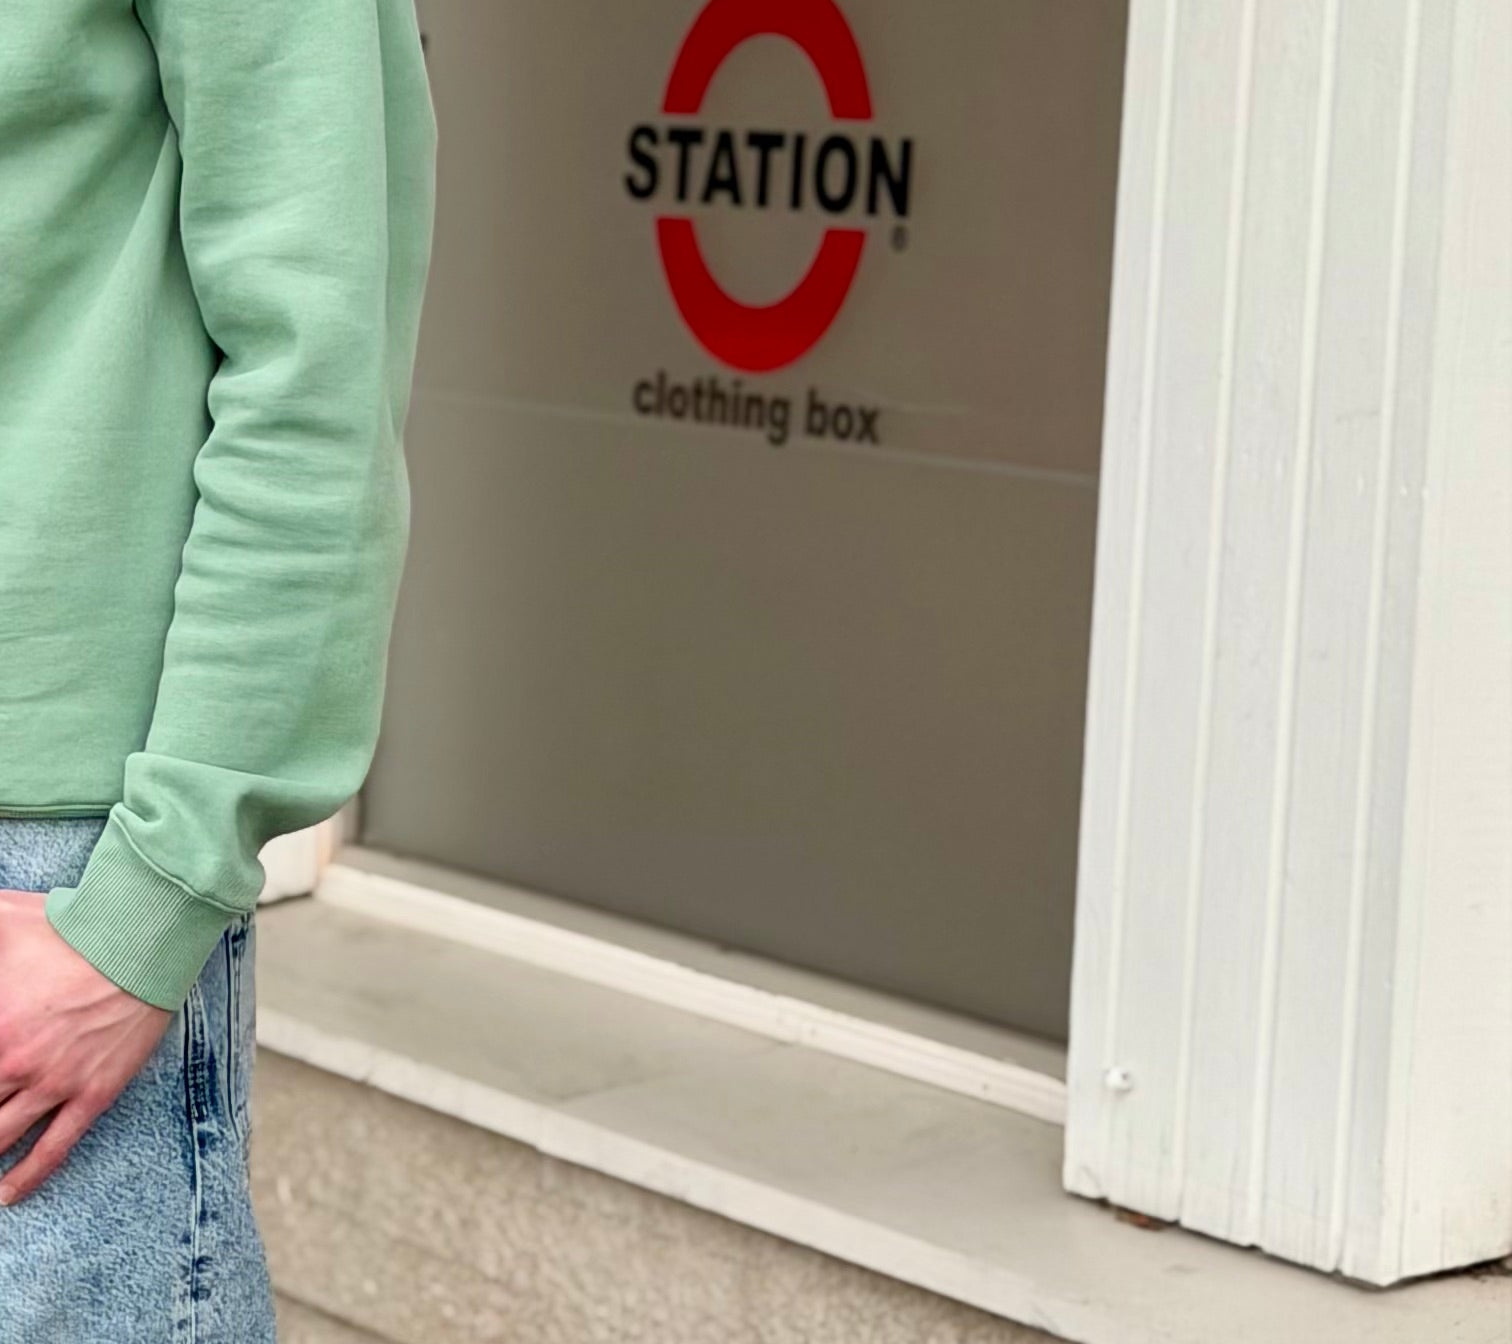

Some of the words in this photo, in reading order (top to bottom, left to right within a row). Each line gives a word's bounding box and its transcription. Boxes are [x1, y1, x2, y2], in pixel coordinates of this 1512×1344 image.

[623, 124, 913, 218] STATION
[632, 370, 792, 446] clothing
[804, 386, 882, 445] box
